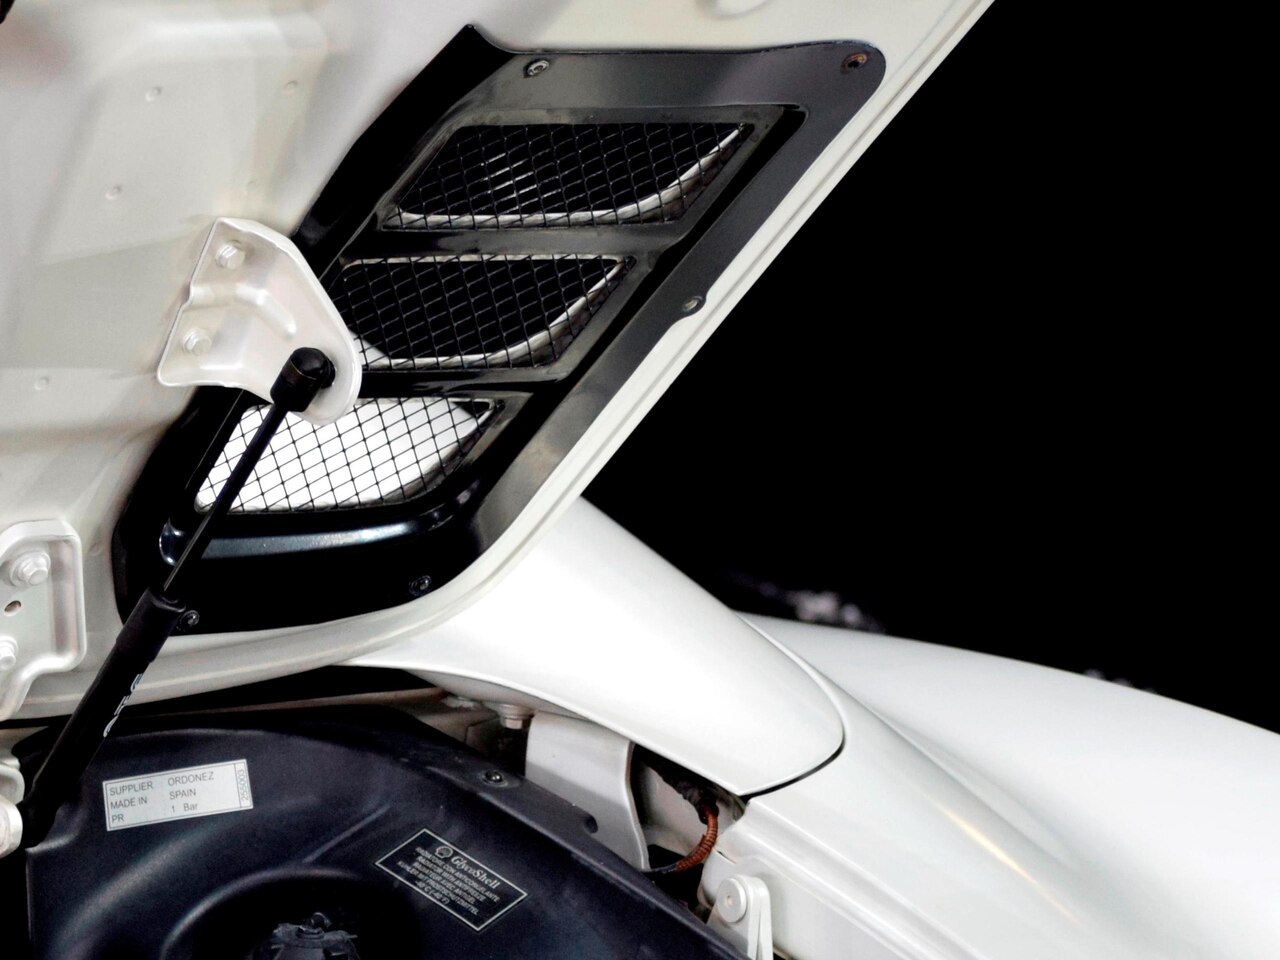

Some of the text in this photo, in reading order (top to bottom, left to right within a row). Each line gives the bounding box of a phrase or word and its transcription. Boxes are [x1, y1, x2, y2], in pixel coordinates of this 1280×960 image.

[109, 771, 214, 796] SUPPLIER ORDONEZ
[110, 788, 197, 810] MADE IN SPAIN
[111, 802, 198, 824] PR 1 Bar
